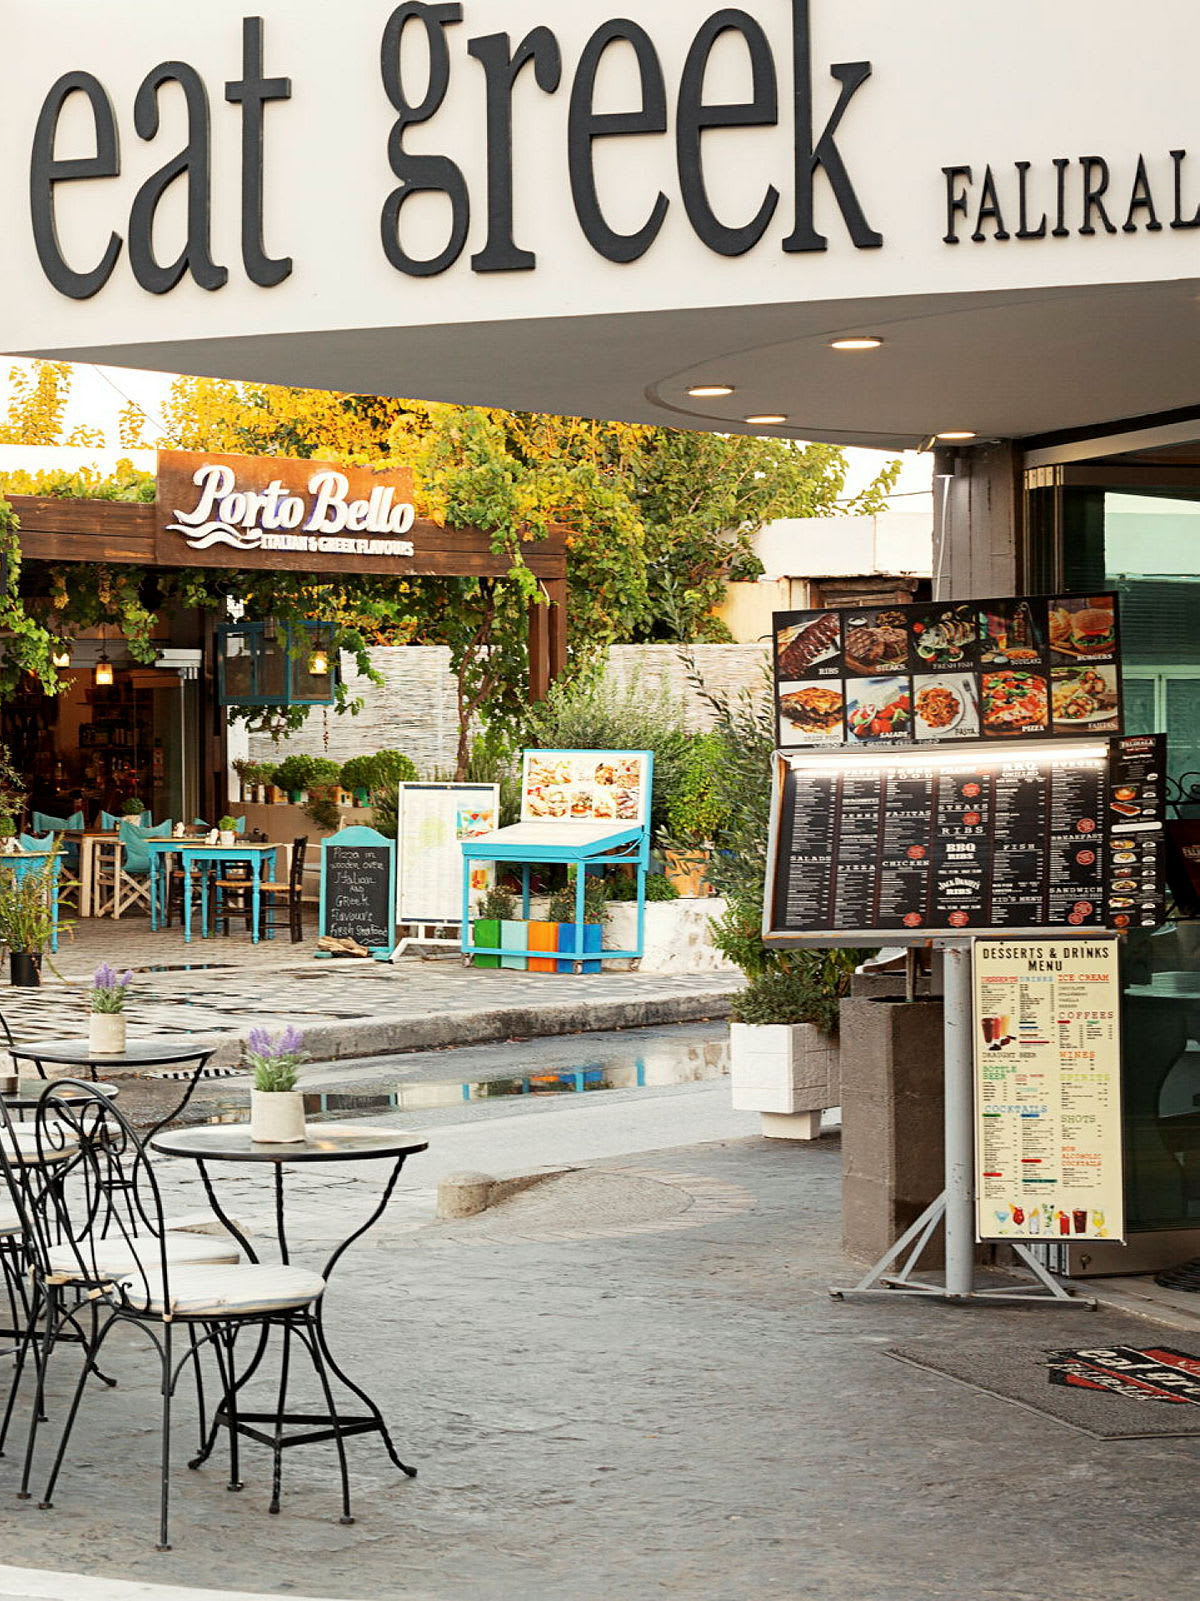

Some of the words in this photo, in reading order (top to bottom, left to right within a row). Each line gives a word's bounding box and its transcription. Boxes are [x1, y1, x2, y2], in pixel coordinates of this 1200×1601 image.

[30, 16, 293, 300] eat
[380, 0, 883, 278] greek
[941, 150, 1200, 244] FALIRAL
[173, 464, 305, 529] Porto
[303, 471, 415, 534] Bello
[261, 533, 308, 551] ITALIAN
[318, 537, 356, 553] GREEK
[356, 539, 415, 557] FLAVOURS
[818, 667, 840, 675] RIBS
[955, 727, 976, 736] PASTA
[1022, 725, 1045, 733] PIZZA
[942, 826, 984, 835] RIBS
[945, 843, 976, 852] BBQ
[983, 948, 1043, 959] DESSERTS
[1049, 948, 1057, 958] &
[1063, 947, 1109, 958] DRINKS
[1028, 960, 1062, 971] MENU
[1059, 1011, 1114, 1019] COFFEES
[985, 1105, 1048, 1113] COCKTAILS
[1061, 1115, 1096, 1123] SHOTS
